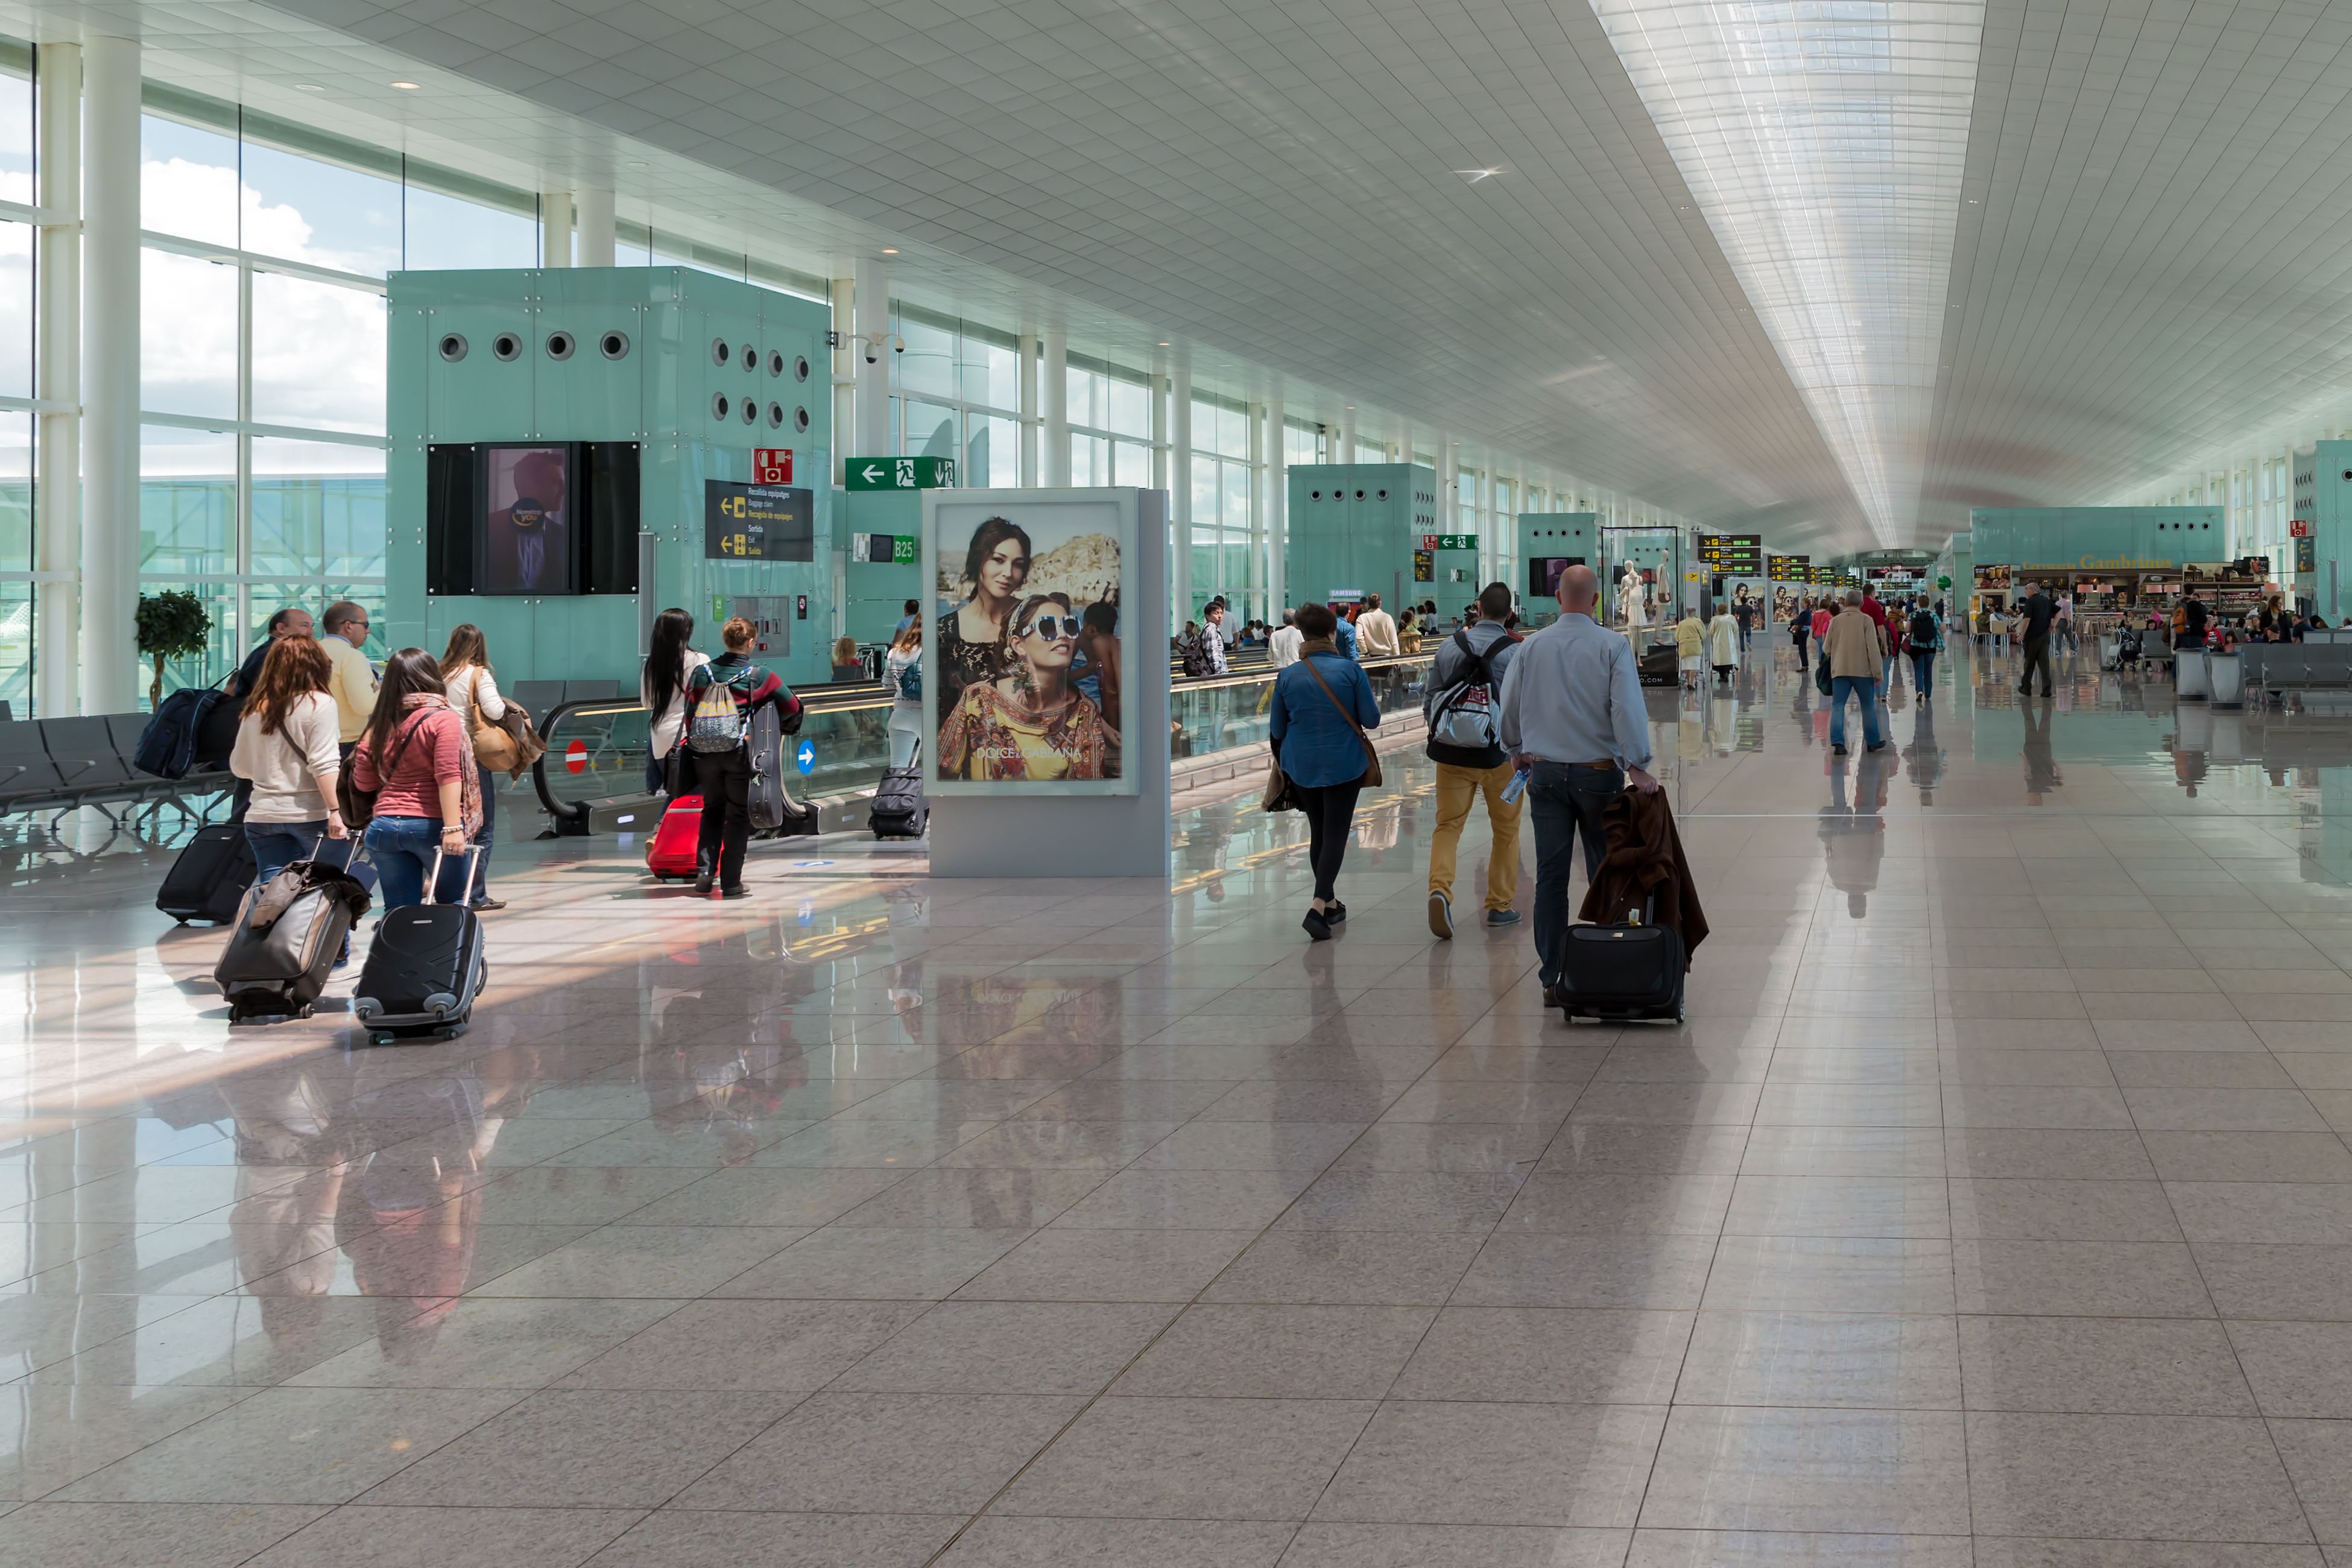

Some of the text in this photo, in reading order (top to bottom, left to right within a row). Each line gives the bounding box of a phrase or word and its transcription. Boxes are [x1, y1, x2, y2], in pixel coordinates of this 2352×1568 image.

[748, 487, 789, 499] Recollida equipatges
[520, 514, 537, 522] you
[748, 510, 767, 519] Recogida
[774, 513, 793, 521] equipajes
[895, 541, 912, 557] B25
[2080, 552, 2171, 569] Gambrinus
